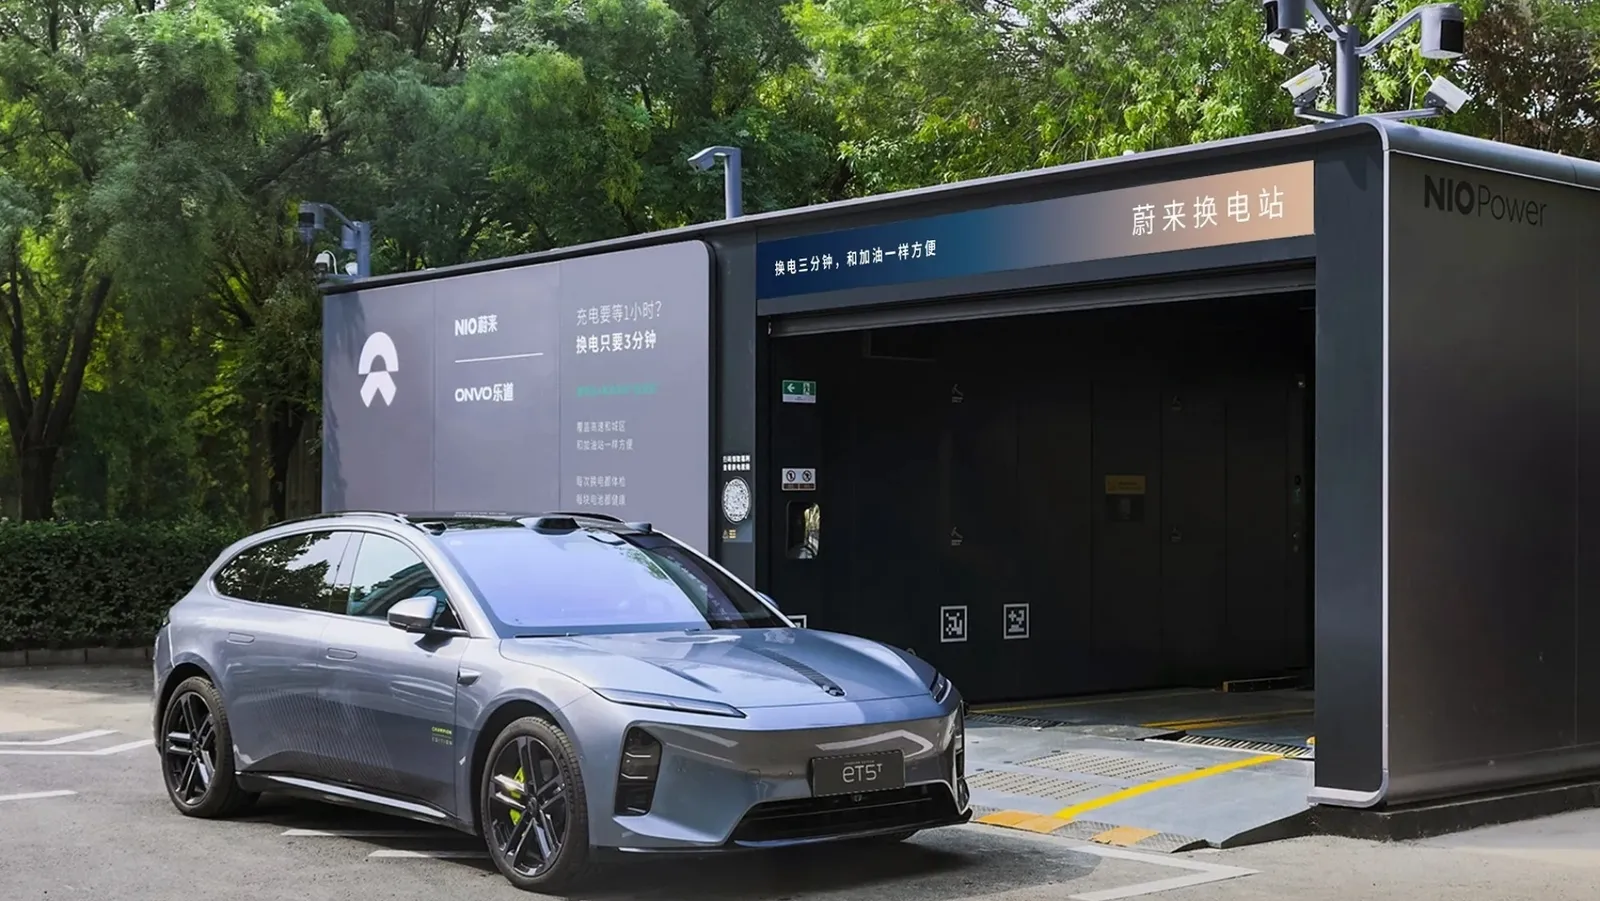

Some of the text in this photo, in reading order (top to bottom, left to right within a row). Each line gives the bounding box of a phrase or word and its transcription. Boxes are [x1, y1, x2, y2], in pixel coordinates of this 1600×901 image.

[1132, 185, 1285, 236] 蔚来换电站
[774, 239, 937, 277] 换电三分钟，和加油一样方便
[576, 329, 657, 354] 换电只要3分钟
